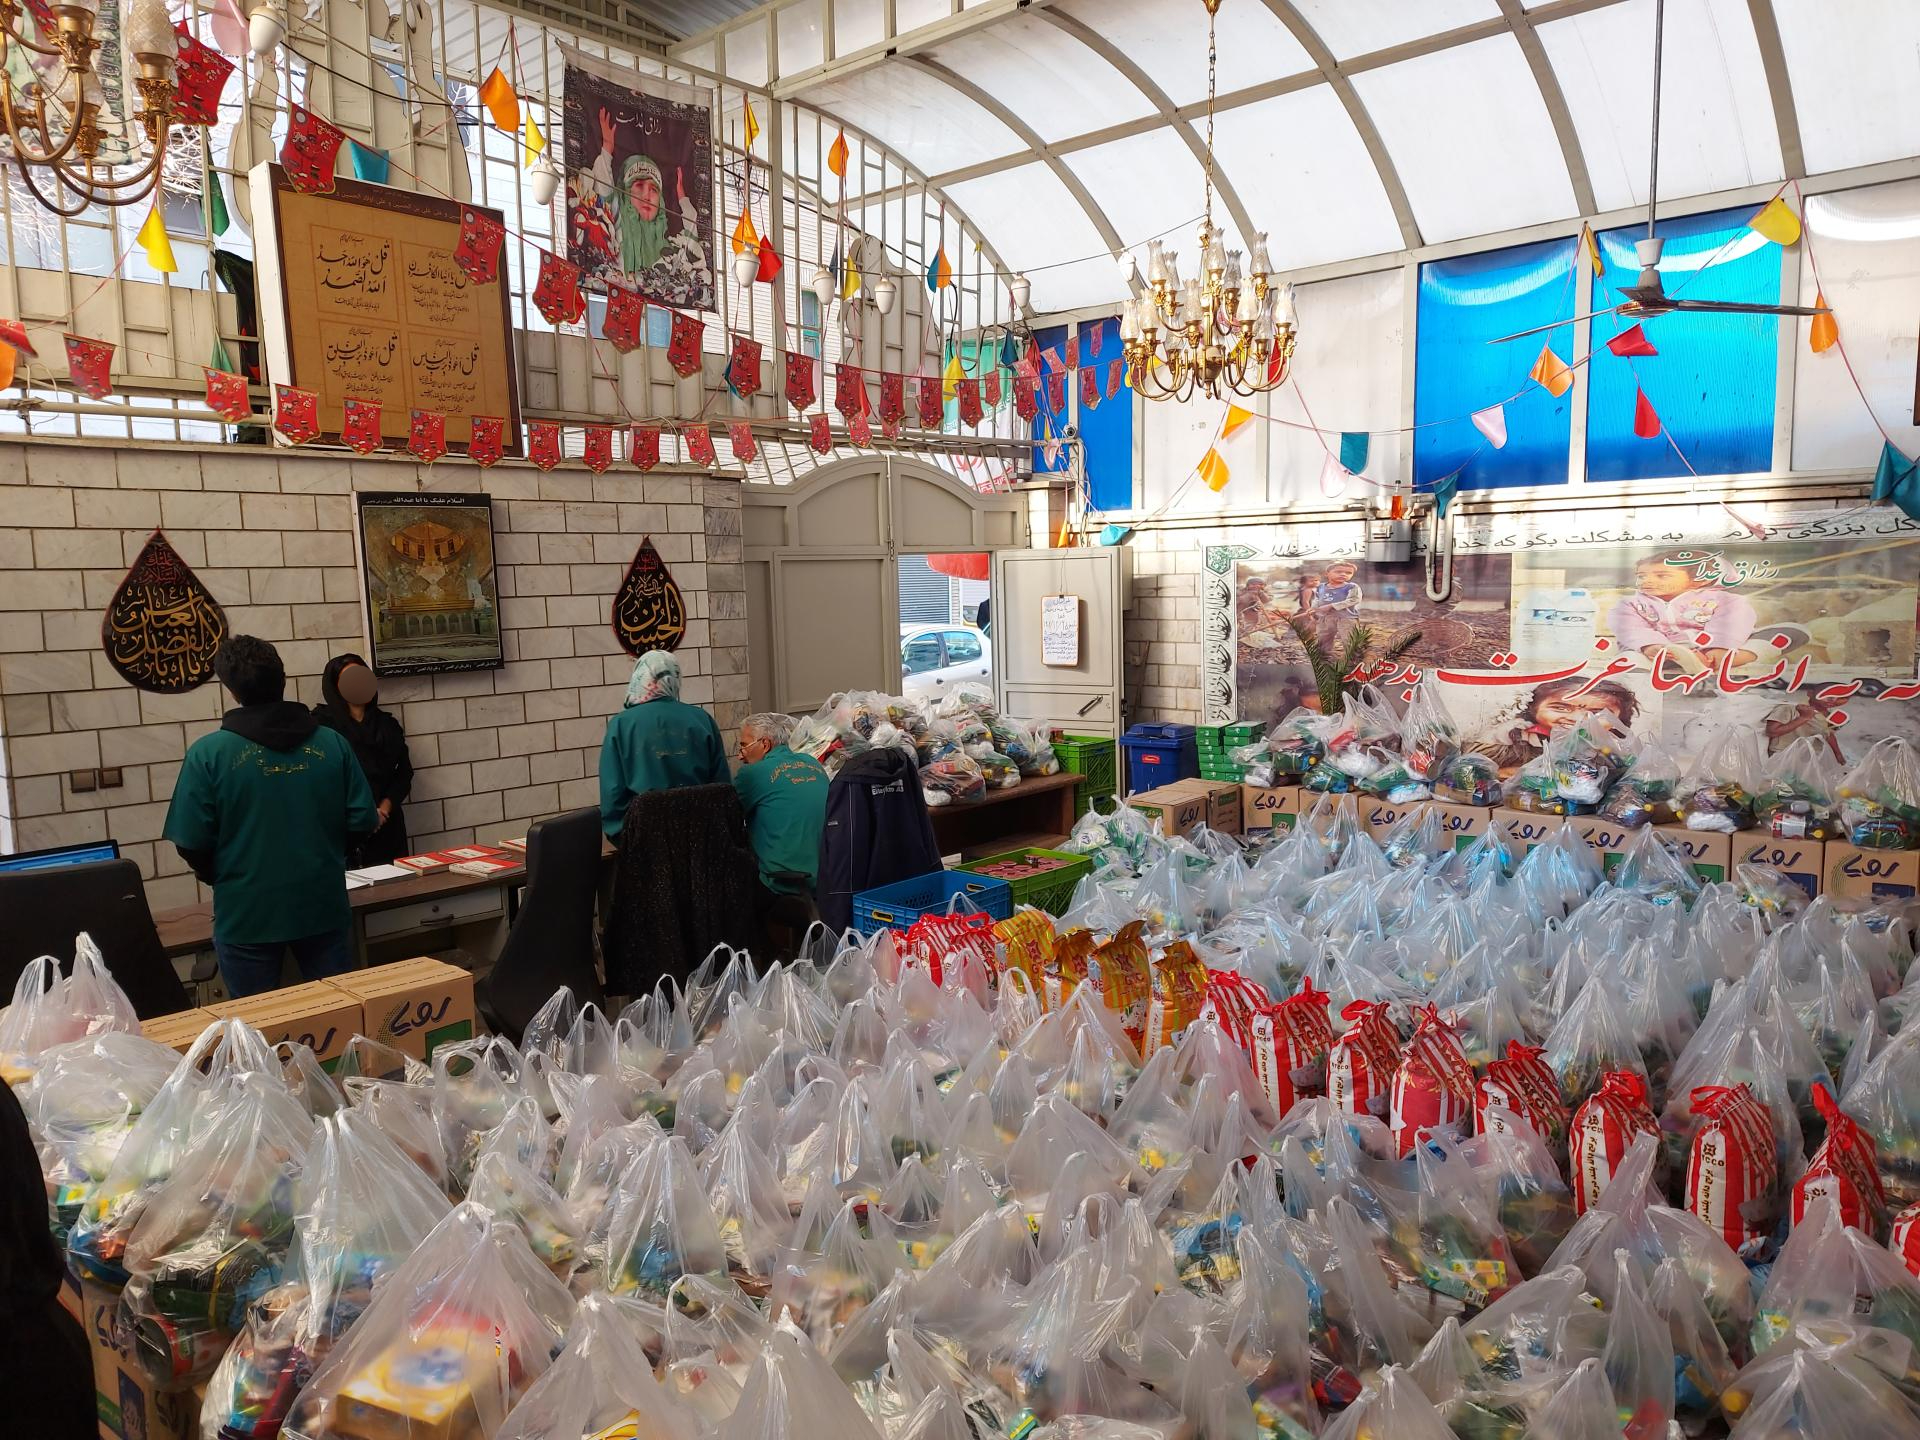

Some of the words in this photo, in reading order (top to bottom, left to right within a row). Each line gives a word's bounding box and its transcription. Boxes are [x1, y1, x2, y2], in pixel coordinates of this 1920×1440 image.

[1723, 527, 1778, 541] درم
[1787, 517, 1866, 540] بزرگی
[1495, 534, 1517, 547] که
[1525, 532, 1557, 549] بگو
[1564, 530, 1654, 545] مشکلت
[1661, 532, 1684, 544] به
[1720, 559, 1780, 587] رزاق
[1436, 637, 1638, 701] عزت
[1651, 631, 1812, 696] انسانها
[1816, 680, 1863, 727] به
[1587, 1136, 1597, 1152] برنج
[1704, 1168, 1713, 1184] برنج
